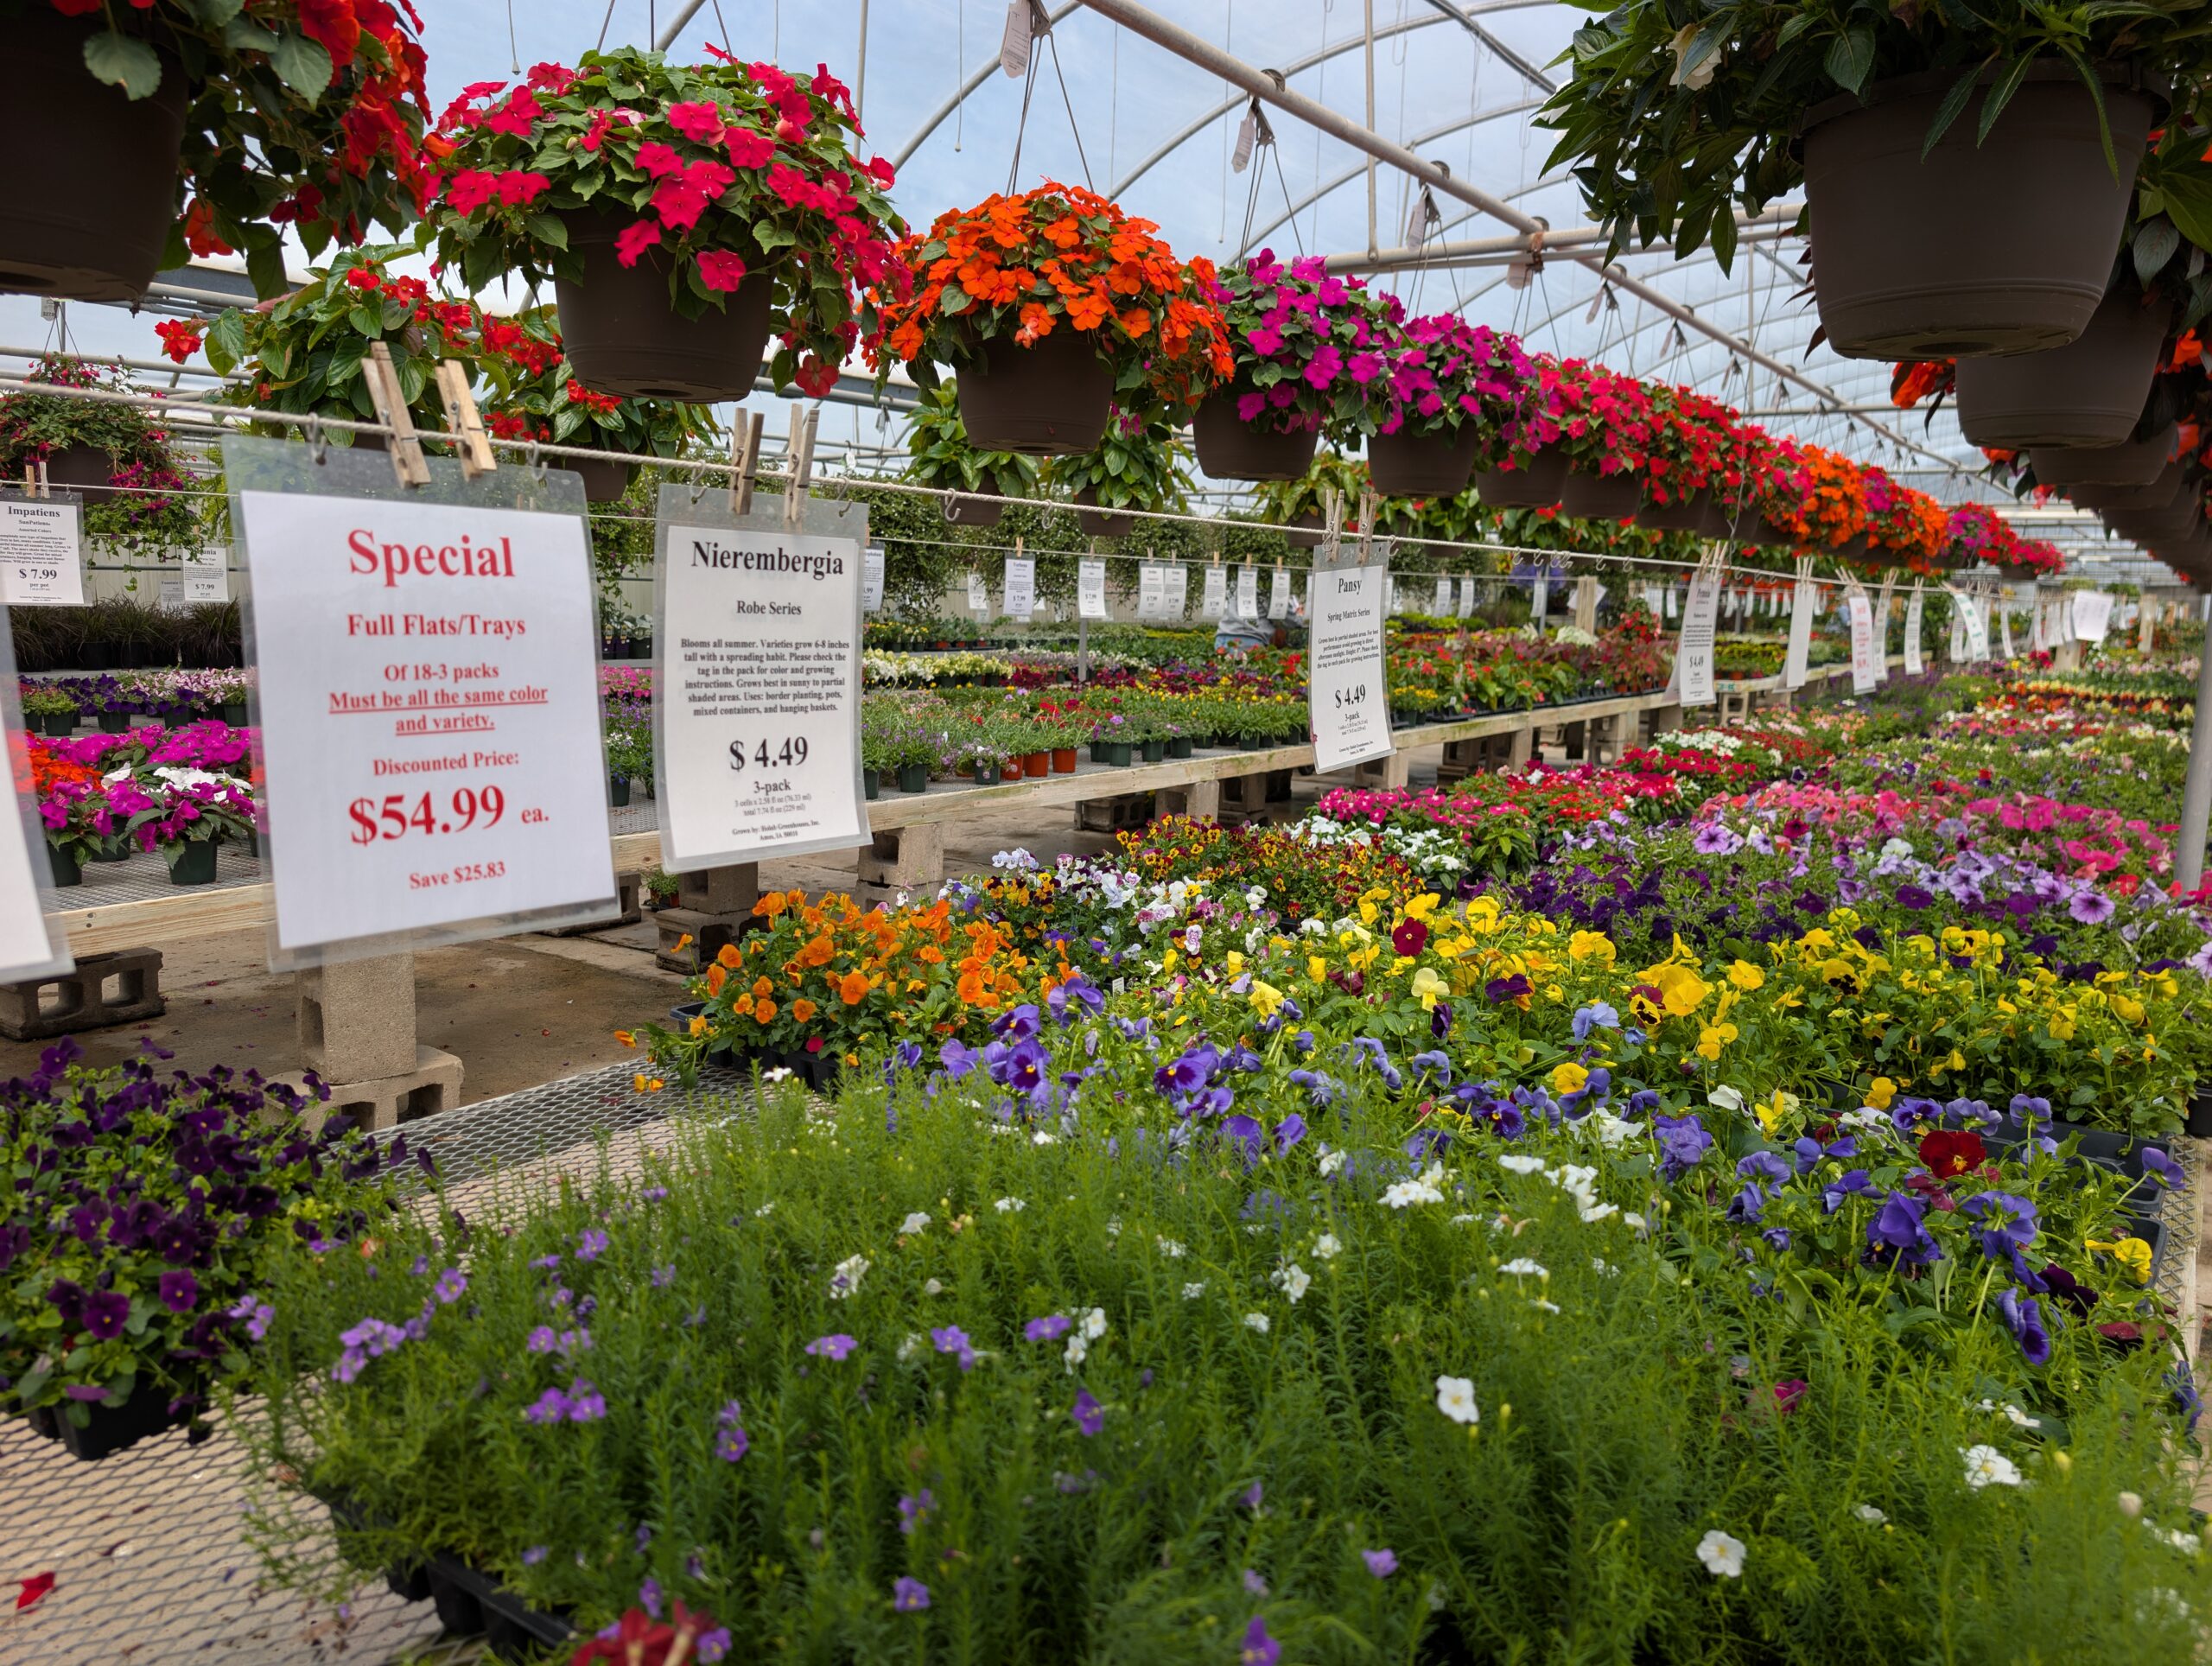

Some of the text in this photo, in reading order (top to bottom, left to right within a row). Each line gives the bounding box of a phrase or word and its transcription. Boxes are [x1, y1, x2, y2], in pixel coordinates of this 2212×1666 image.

[9, 506, 60, 518] Impatiens
[347, 529, 516, 588] Special
[691, 541, 843, 581] Nierembergia
[19, 569, 57, 580] $ 7.99
[1338, 577, 1363, 595] Pansy
[737, 601, 802, 615] Robe Series
[1327, 608, 1370, 622] Spring Matrix Series
[347, 614, 526, 640] Full Flats/Trays
[681, 639, 710, 648] Blooms
[713, 639, 722, 648] all
[760, 639, 793, 648] Varieties
[828, 640, 849, 649] inches
[700, 653, 717, 662] with
[726, 653, 764, 663] spreading
[1689, 655, 1704, 668] $ 4.49
[385, 662, 499, 684] Of 18-3 packs
[697, 667, 710, 677] tag
[712, 666, 720, 675] in
[722, 666, 734, 675] the
[737, 666, 755, 677] pack
[770, 665, 788, 674] color
[791, 665, 804, 674] and
[805, 665, 835, 676] growing
[685, 679, 734, 689] instructions.
[736, 679, 762, 688] Grows
[764, 678, 778, 687] best
[780, 678, 787, 687] in
[789, 679, 810, 689] sunny
[821, 677, 845, 688] partial
[329, 685, 549, 711] Must be all the same color
[688, 693, 716, 703] shaded
[744, 692, 764, 701] Uses:
[766, 691, 791, 700] border
[1335, 684, 1366, 709] $ 4.49
[693, 703, 838, 716] mixed containers, and hanging baskets.
[1344, 710, 1360, 722] 3-pack
[395, 712, 495, 732] and variety.
[729, 736, 809, 773] $ 4.49
[372, 751, 520, 776] Discounted Price:
[753, 779, 791, 796] 3-pack
[348, 785, 550, 847] $54.99 ea.
[410, 861, 506, 889] Save $25.83
